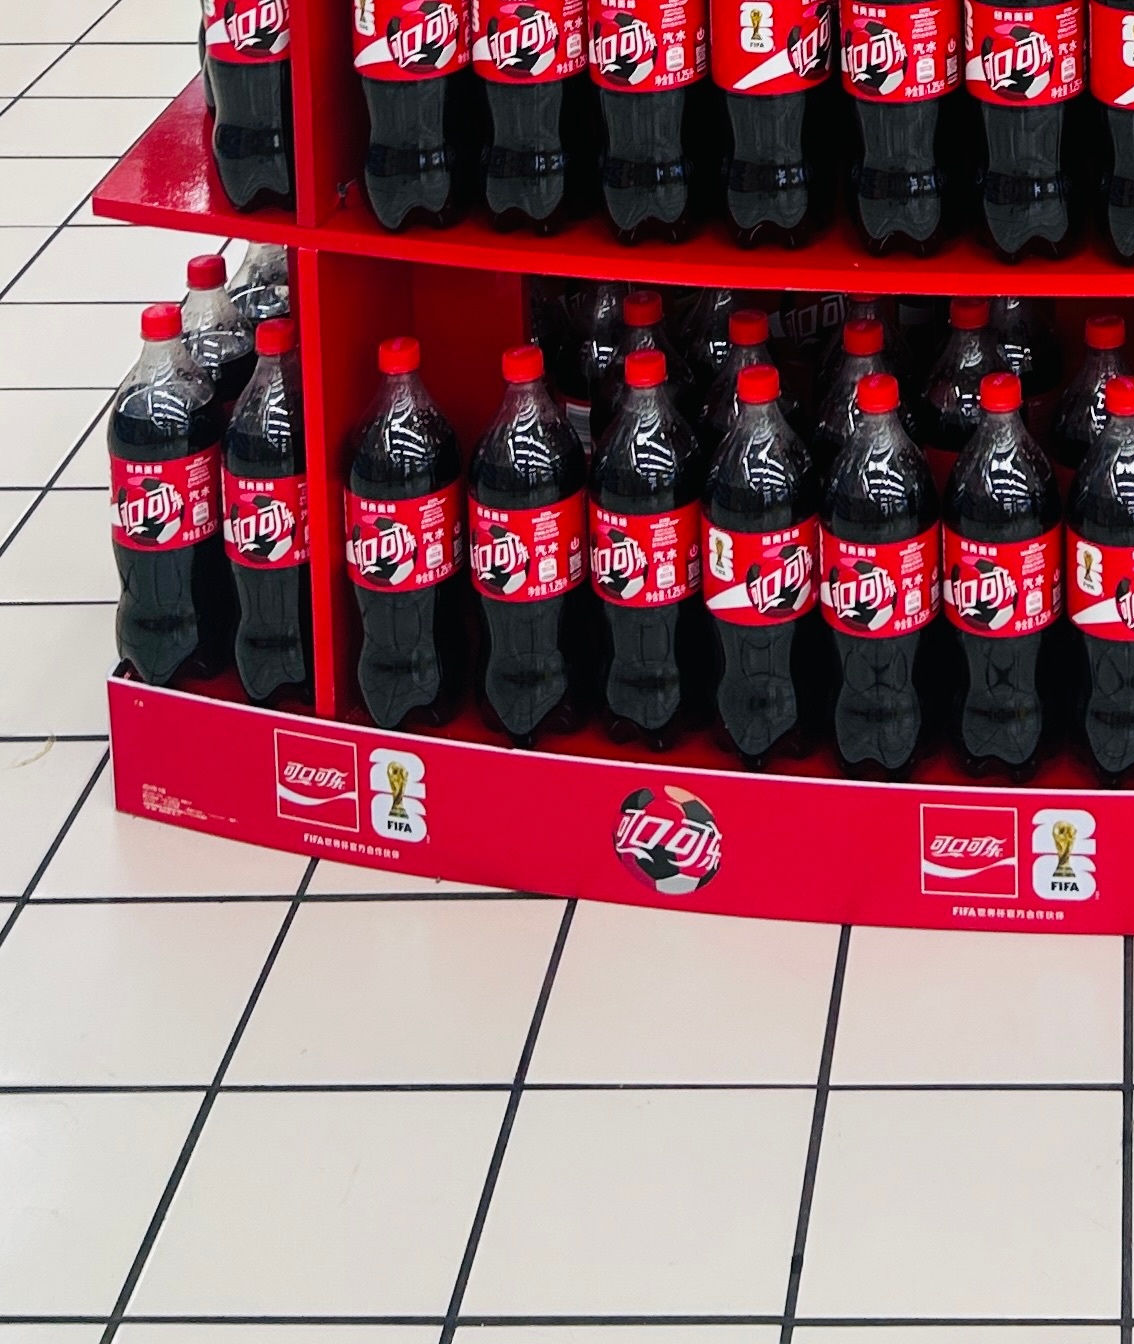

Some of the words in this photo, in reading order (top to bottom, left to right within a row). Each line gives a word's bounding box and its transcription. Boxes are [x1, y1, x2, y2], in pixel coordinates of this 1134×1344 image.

[284, 761, 348, 790] 可口可乐
[387, 820, 412, 834] FIFA
[616, 810, 723, 870] 可口可乐
[930, 835, 1007, 858] 可口可乐
[1051, 881, 1079, 892] FIFA
